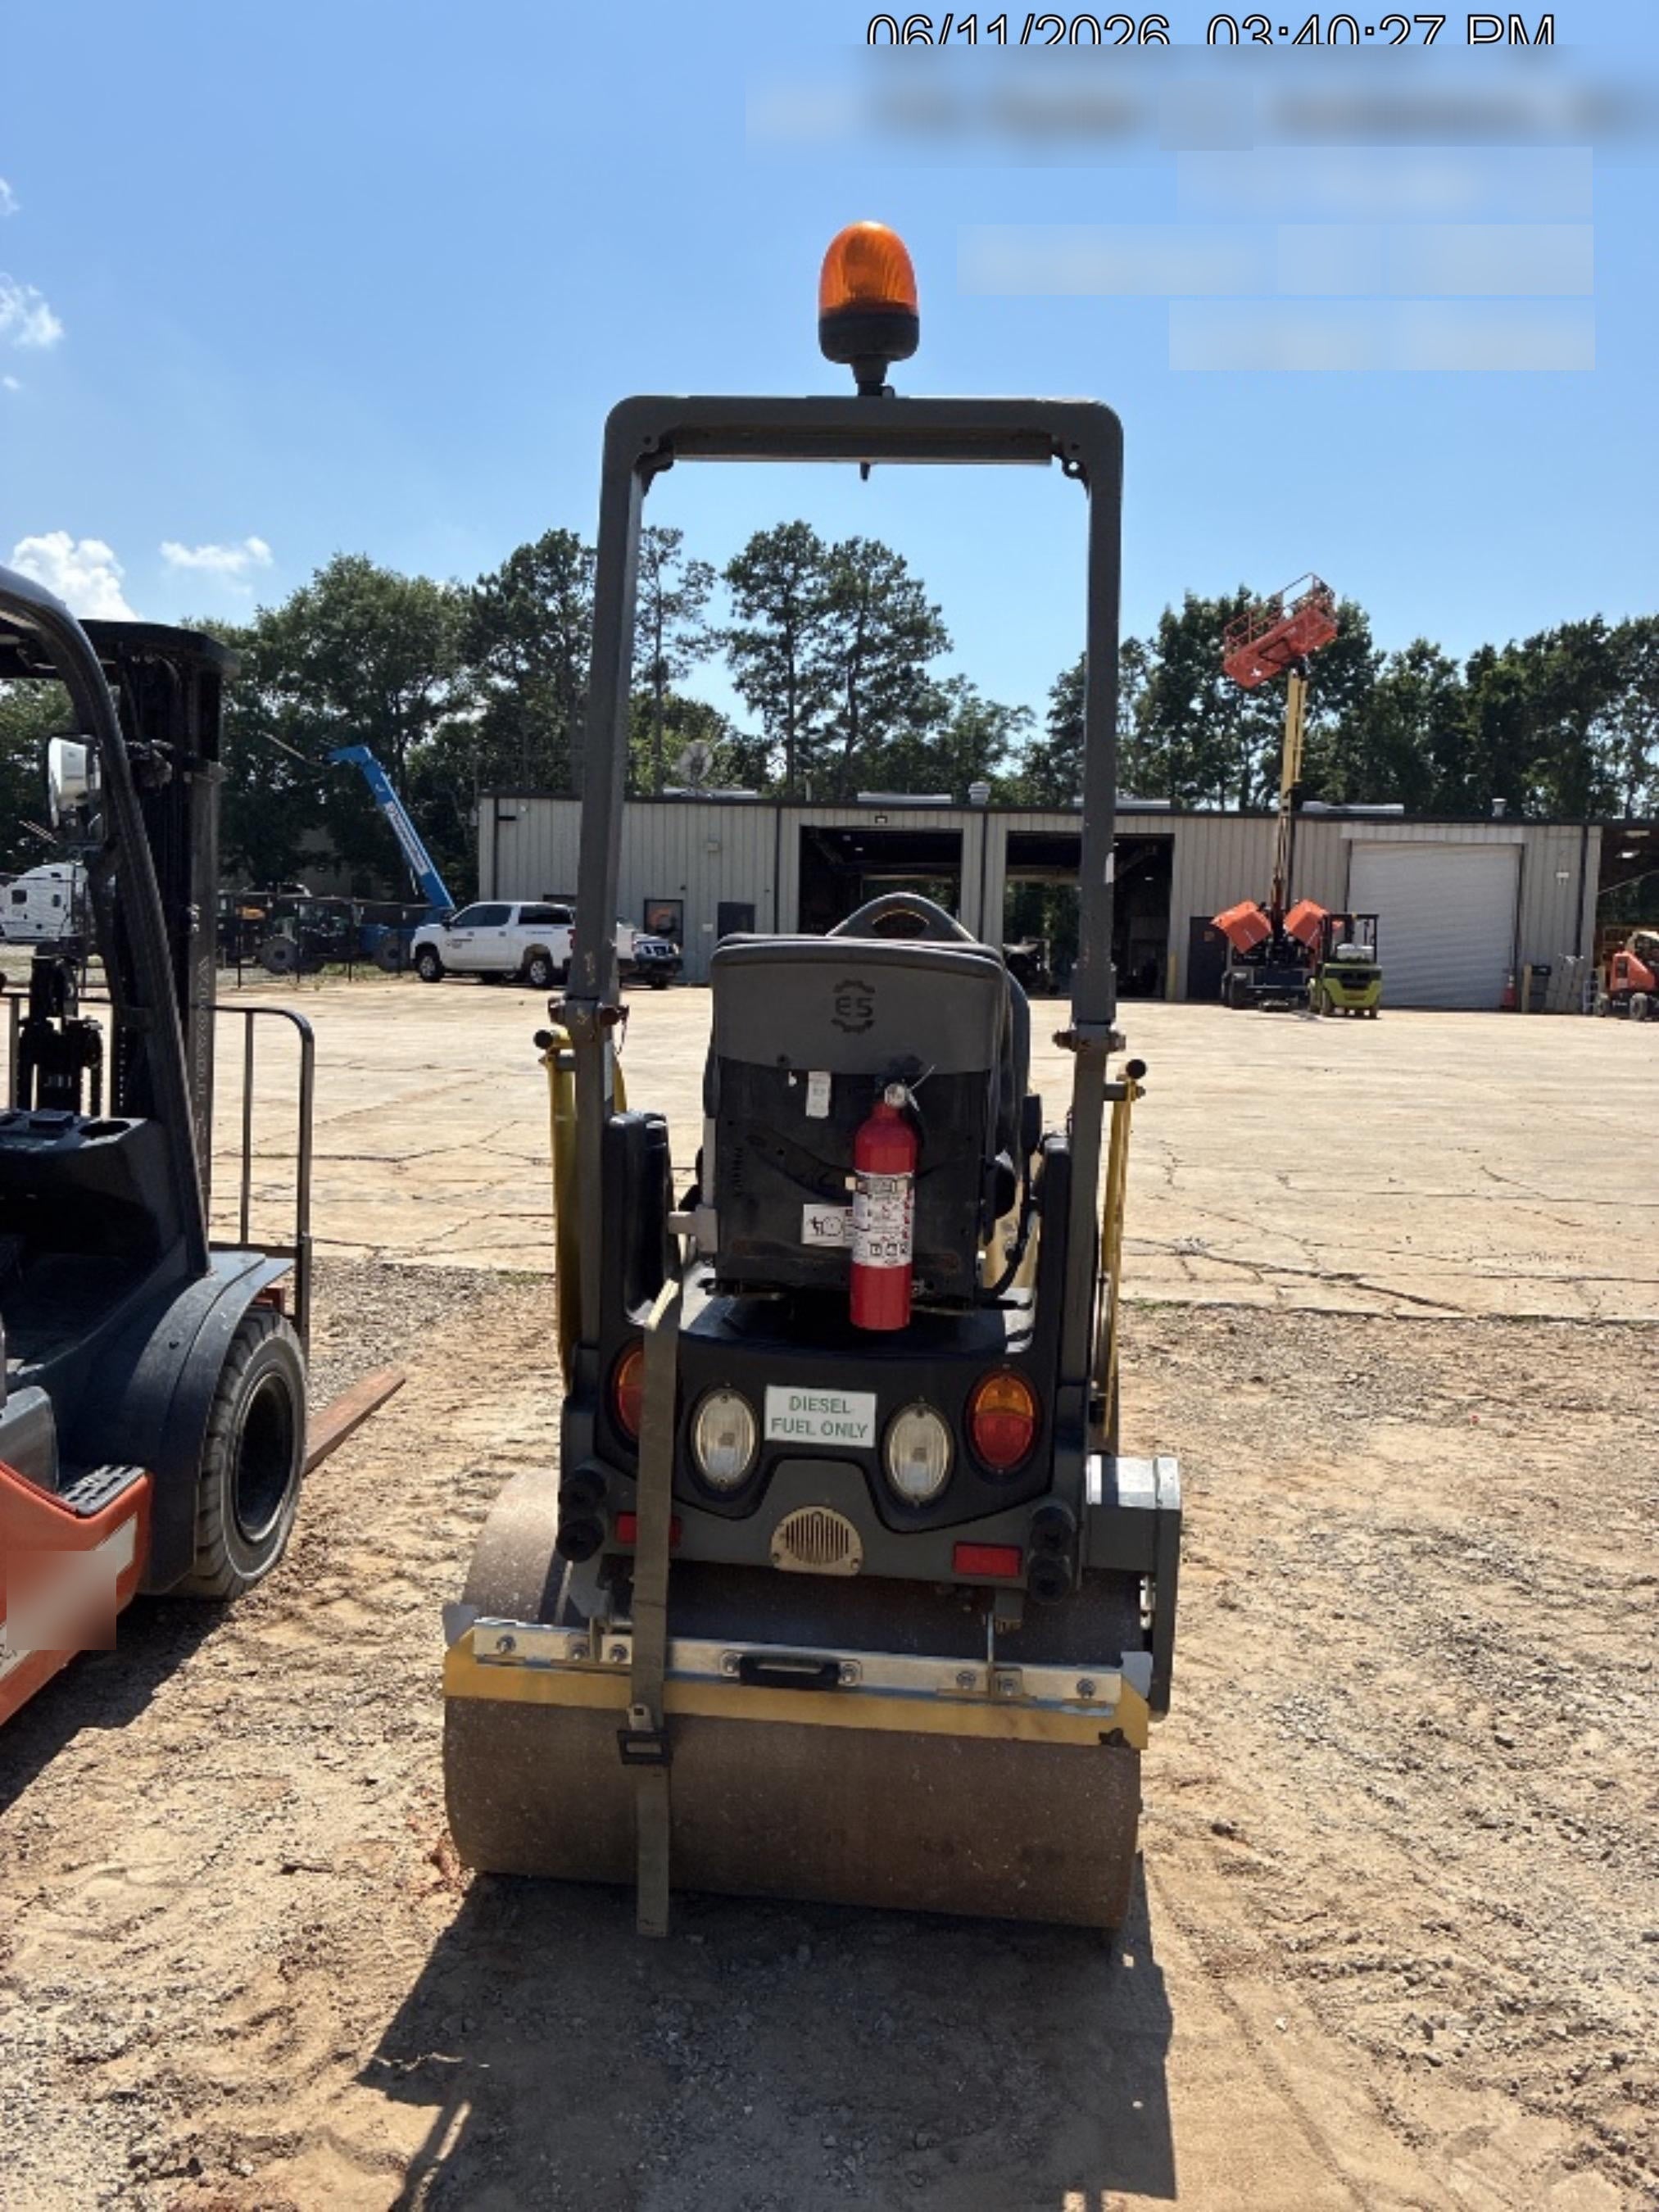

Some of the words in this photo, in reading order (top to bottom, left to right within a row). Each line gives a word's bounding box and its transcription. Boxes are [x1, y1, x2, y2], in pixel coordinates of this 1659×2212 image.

[790, 1395, 850, 1414] DIESEL
[771, 1417, 817, 1436] FUEL
[820, 1419, 868, 1439] ONLY
